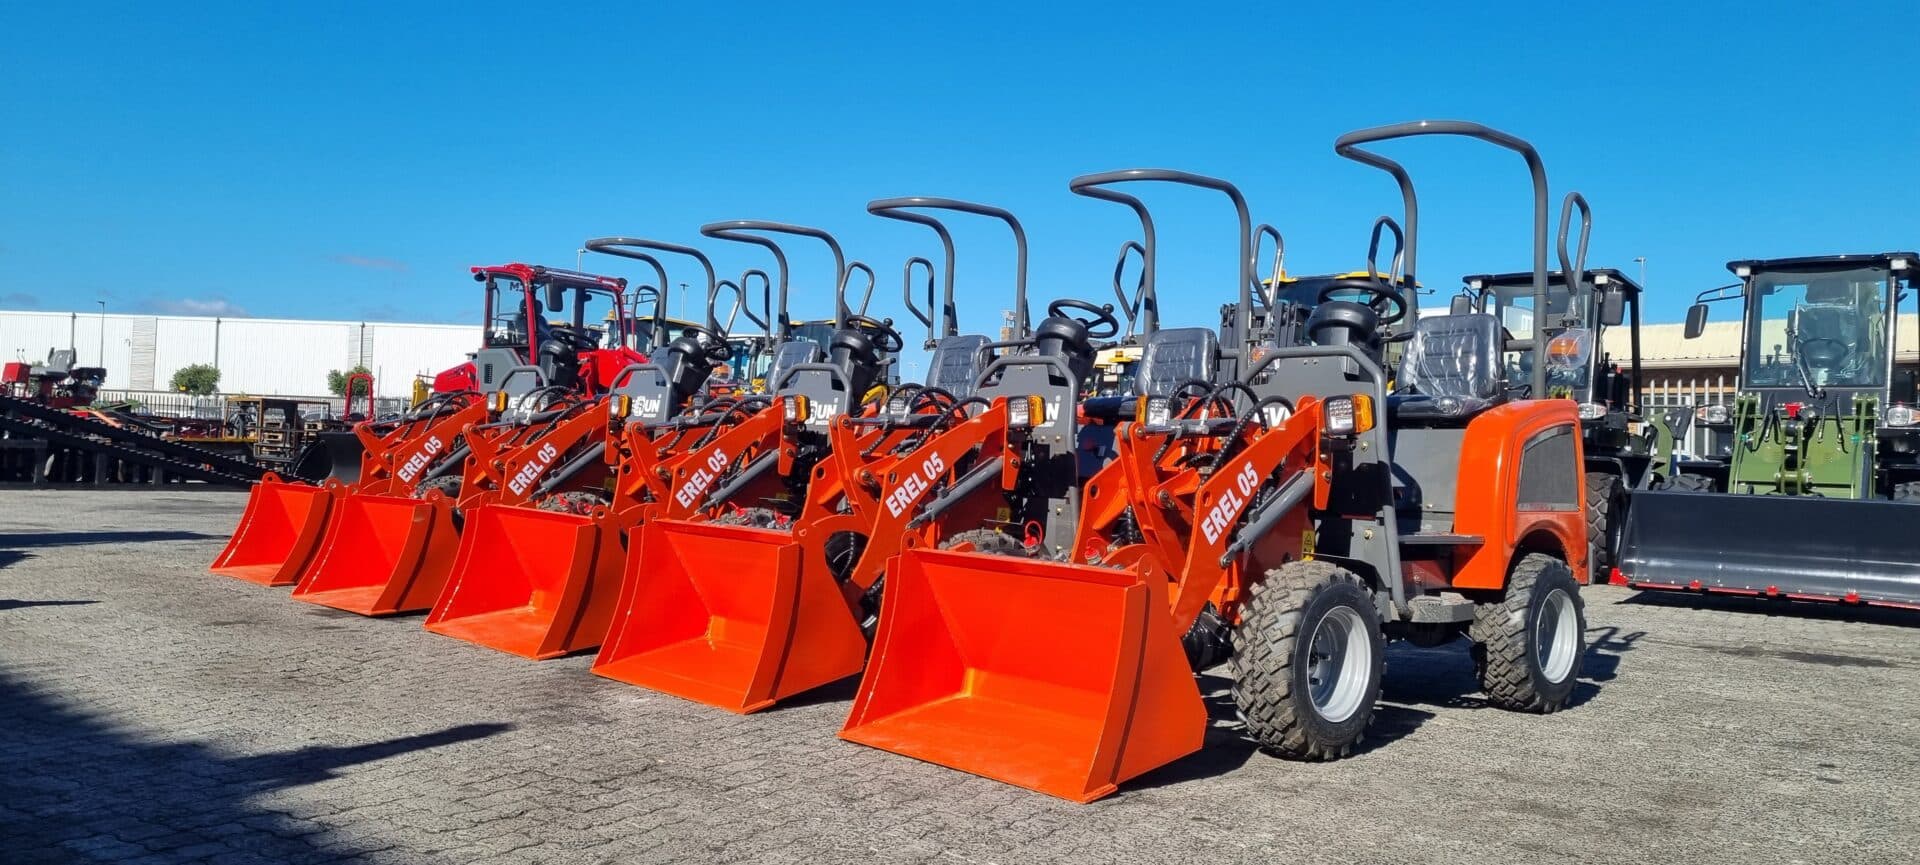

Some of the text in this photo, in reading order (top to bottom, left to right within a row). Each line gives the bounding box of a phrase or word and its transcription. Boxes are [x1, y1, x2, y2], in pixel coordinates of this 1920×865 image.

[397, 435, 442, 483] EREL 05
[508, 442, 557, 496] EREL 05
[675, 448, 727, 509] EREL 05
[885, 451, 944, 519] EREL 05
[1200, 461, 1259, 546] EREL 05
